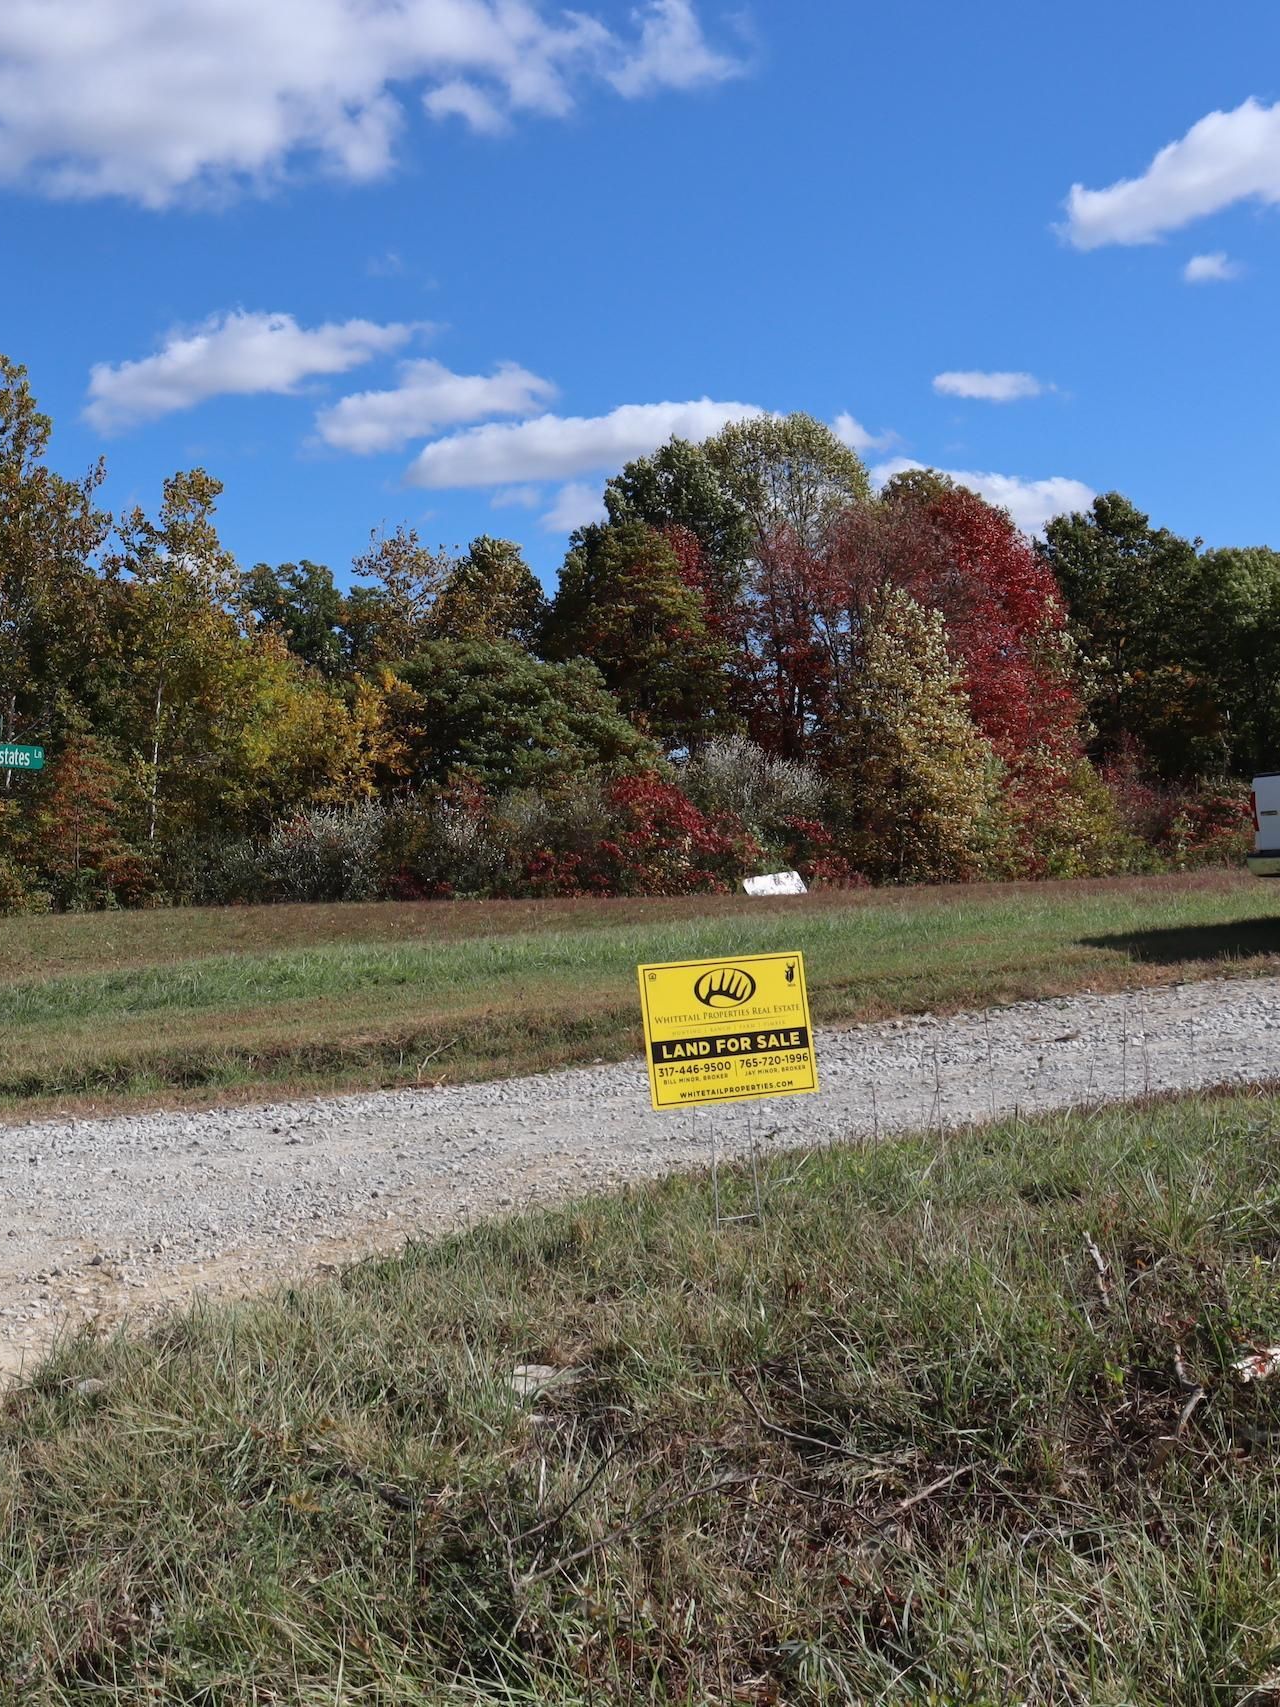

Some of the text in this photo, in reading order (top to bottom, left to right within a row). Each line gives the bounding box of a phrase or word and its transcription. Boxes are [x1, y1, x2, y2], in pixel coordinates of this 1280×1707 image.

[34, 749, 42, 758] Ln
[655, 1004, 800, 1024] WHITETAIL PROPERTIES REAL ESTATE
[662, 1032, 801, 1059] LAND FOR SALE
[740, 1053, 809, 1068] 765-720-1996
[658, 1061, 731, 1077] 317-446-9500
[781, 1065, 806, 1073] BROKER
[703, 1073, 729, 1081] BROKER
[679, 1080, 793, 1099] WHITETAILPROPERTIES.COM
